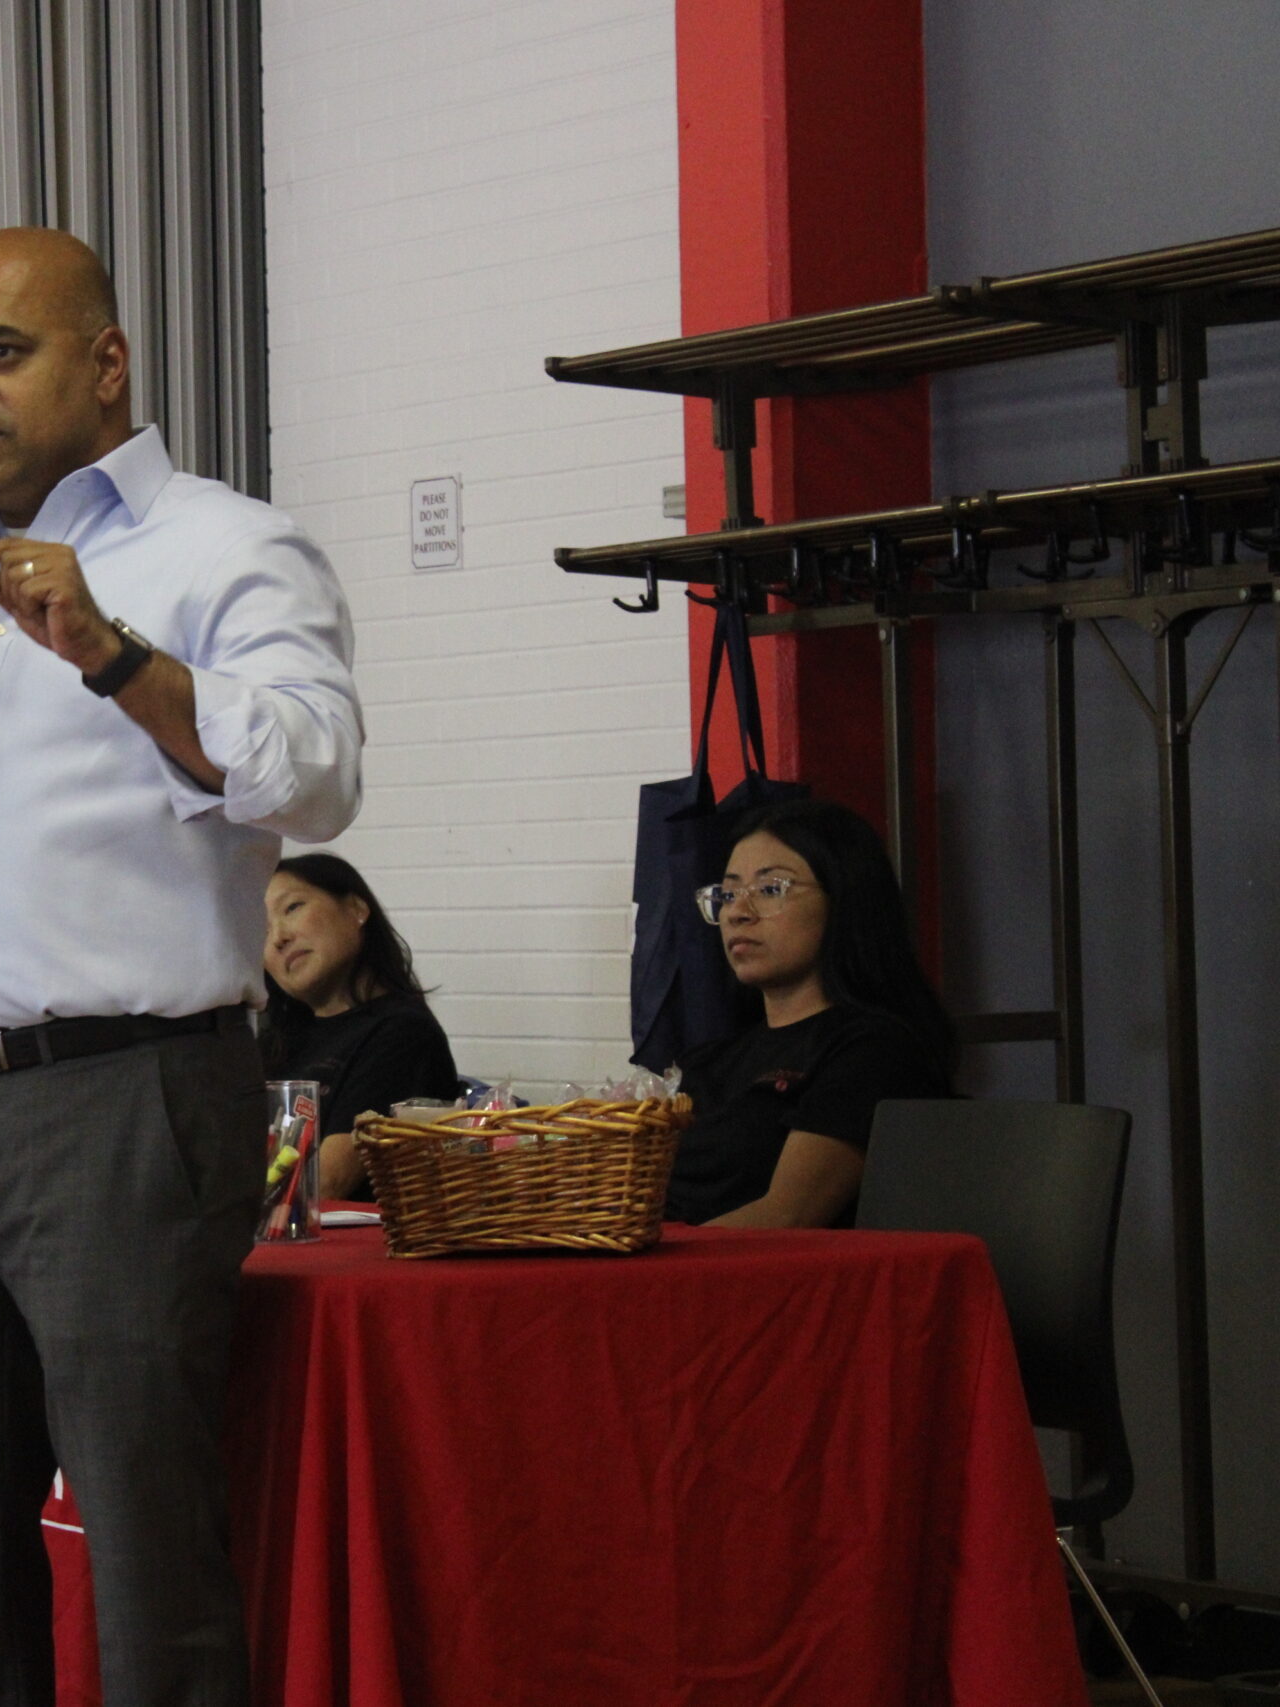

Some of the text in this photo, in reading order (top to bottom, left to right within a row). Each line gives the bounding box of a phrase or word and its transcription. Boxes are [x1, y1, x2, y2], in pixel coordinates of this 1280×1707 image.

[422, 492, 447, 506] PLEASE
[419, 508, 449, 522] DO NOT
[424, 525, 446, 537] MOVE
[414, 540, 457, 554] PARTITIONS
